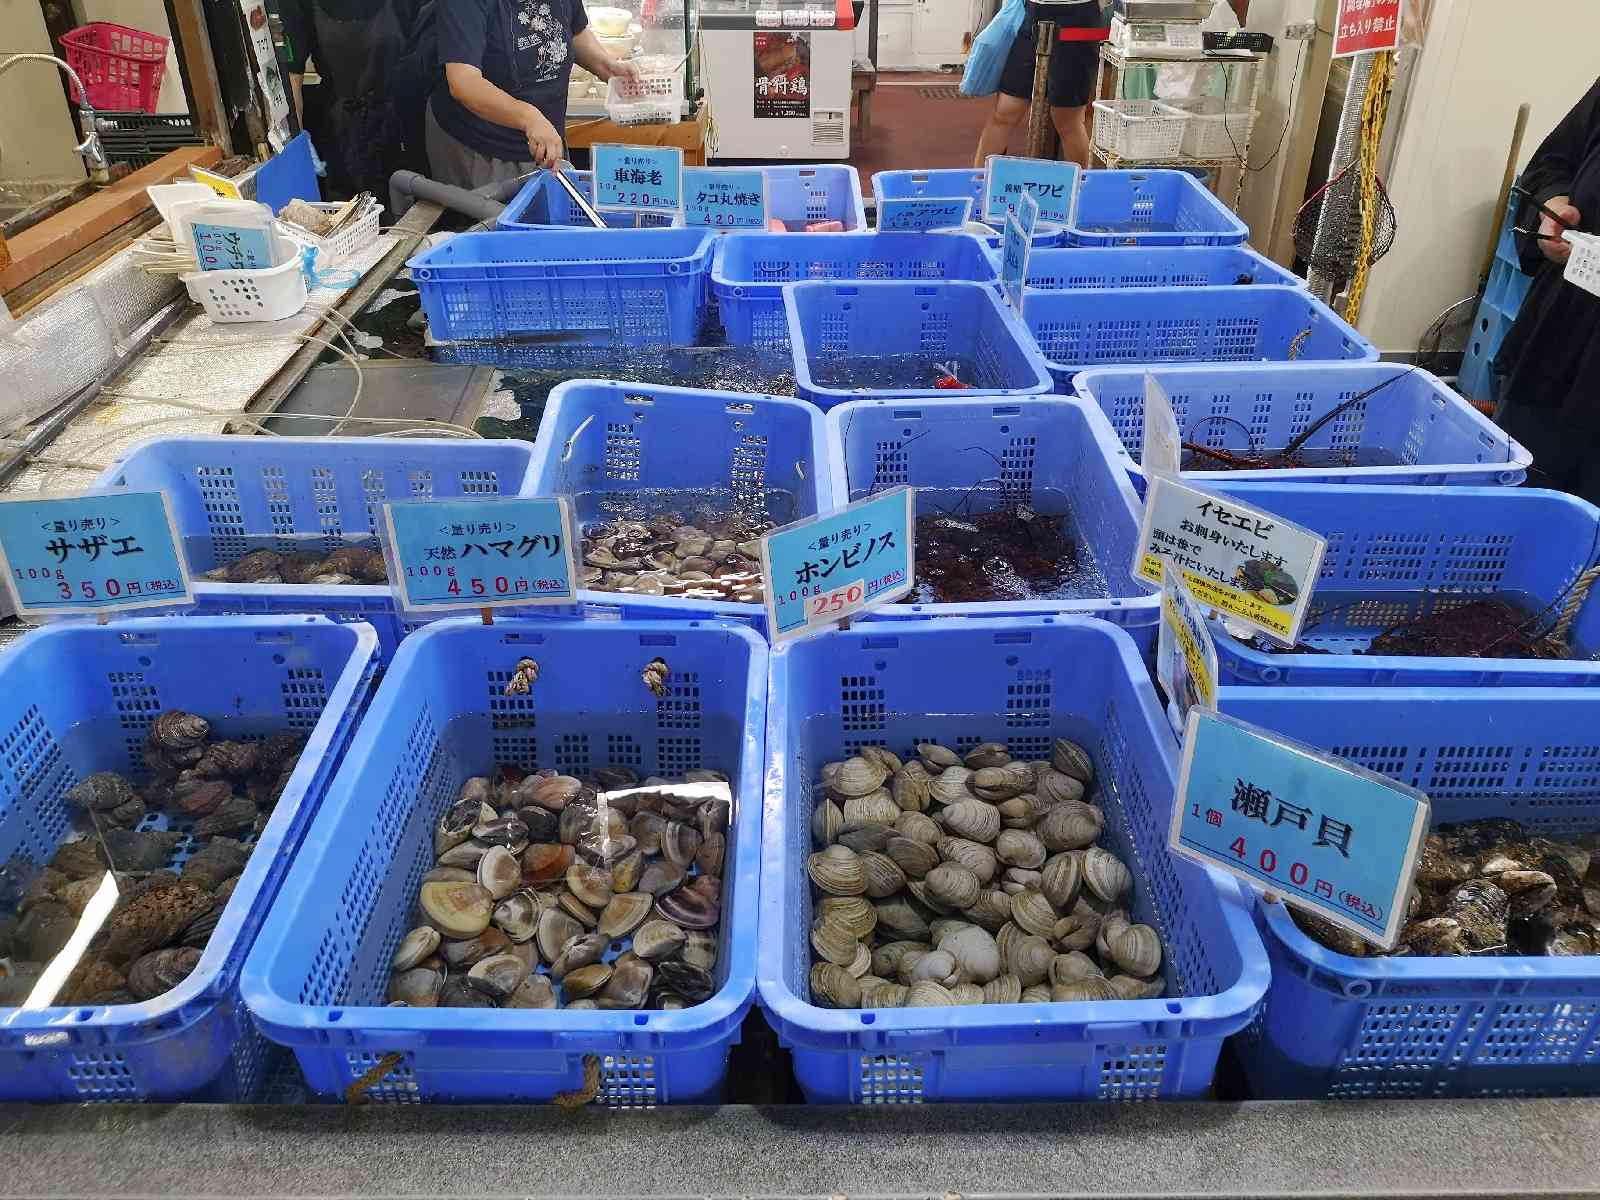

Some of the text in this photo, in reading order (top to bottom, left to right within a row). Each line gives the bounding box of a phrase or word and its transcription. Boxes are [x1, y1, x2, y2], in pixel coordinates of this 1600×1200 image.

[1339, 16, 1395, 38] 立ち入り禁止
[614, 167, 663, 186] 車海老
[696, 192, 761, 206] タコ丸焼き
[1197, 500, 1275, 540] イセエビ
[45, 535, 145, 564] サザエ
[1152, 527, 1202, 556] 頭は後で
[1180, 519, 1288, 571] お刺身いたします
[795, 531, 896, 584] ホンビノス
[1191, 802, 1224, 828] 1個
[1230, 777, 1354, 858] 瀬戸貝
